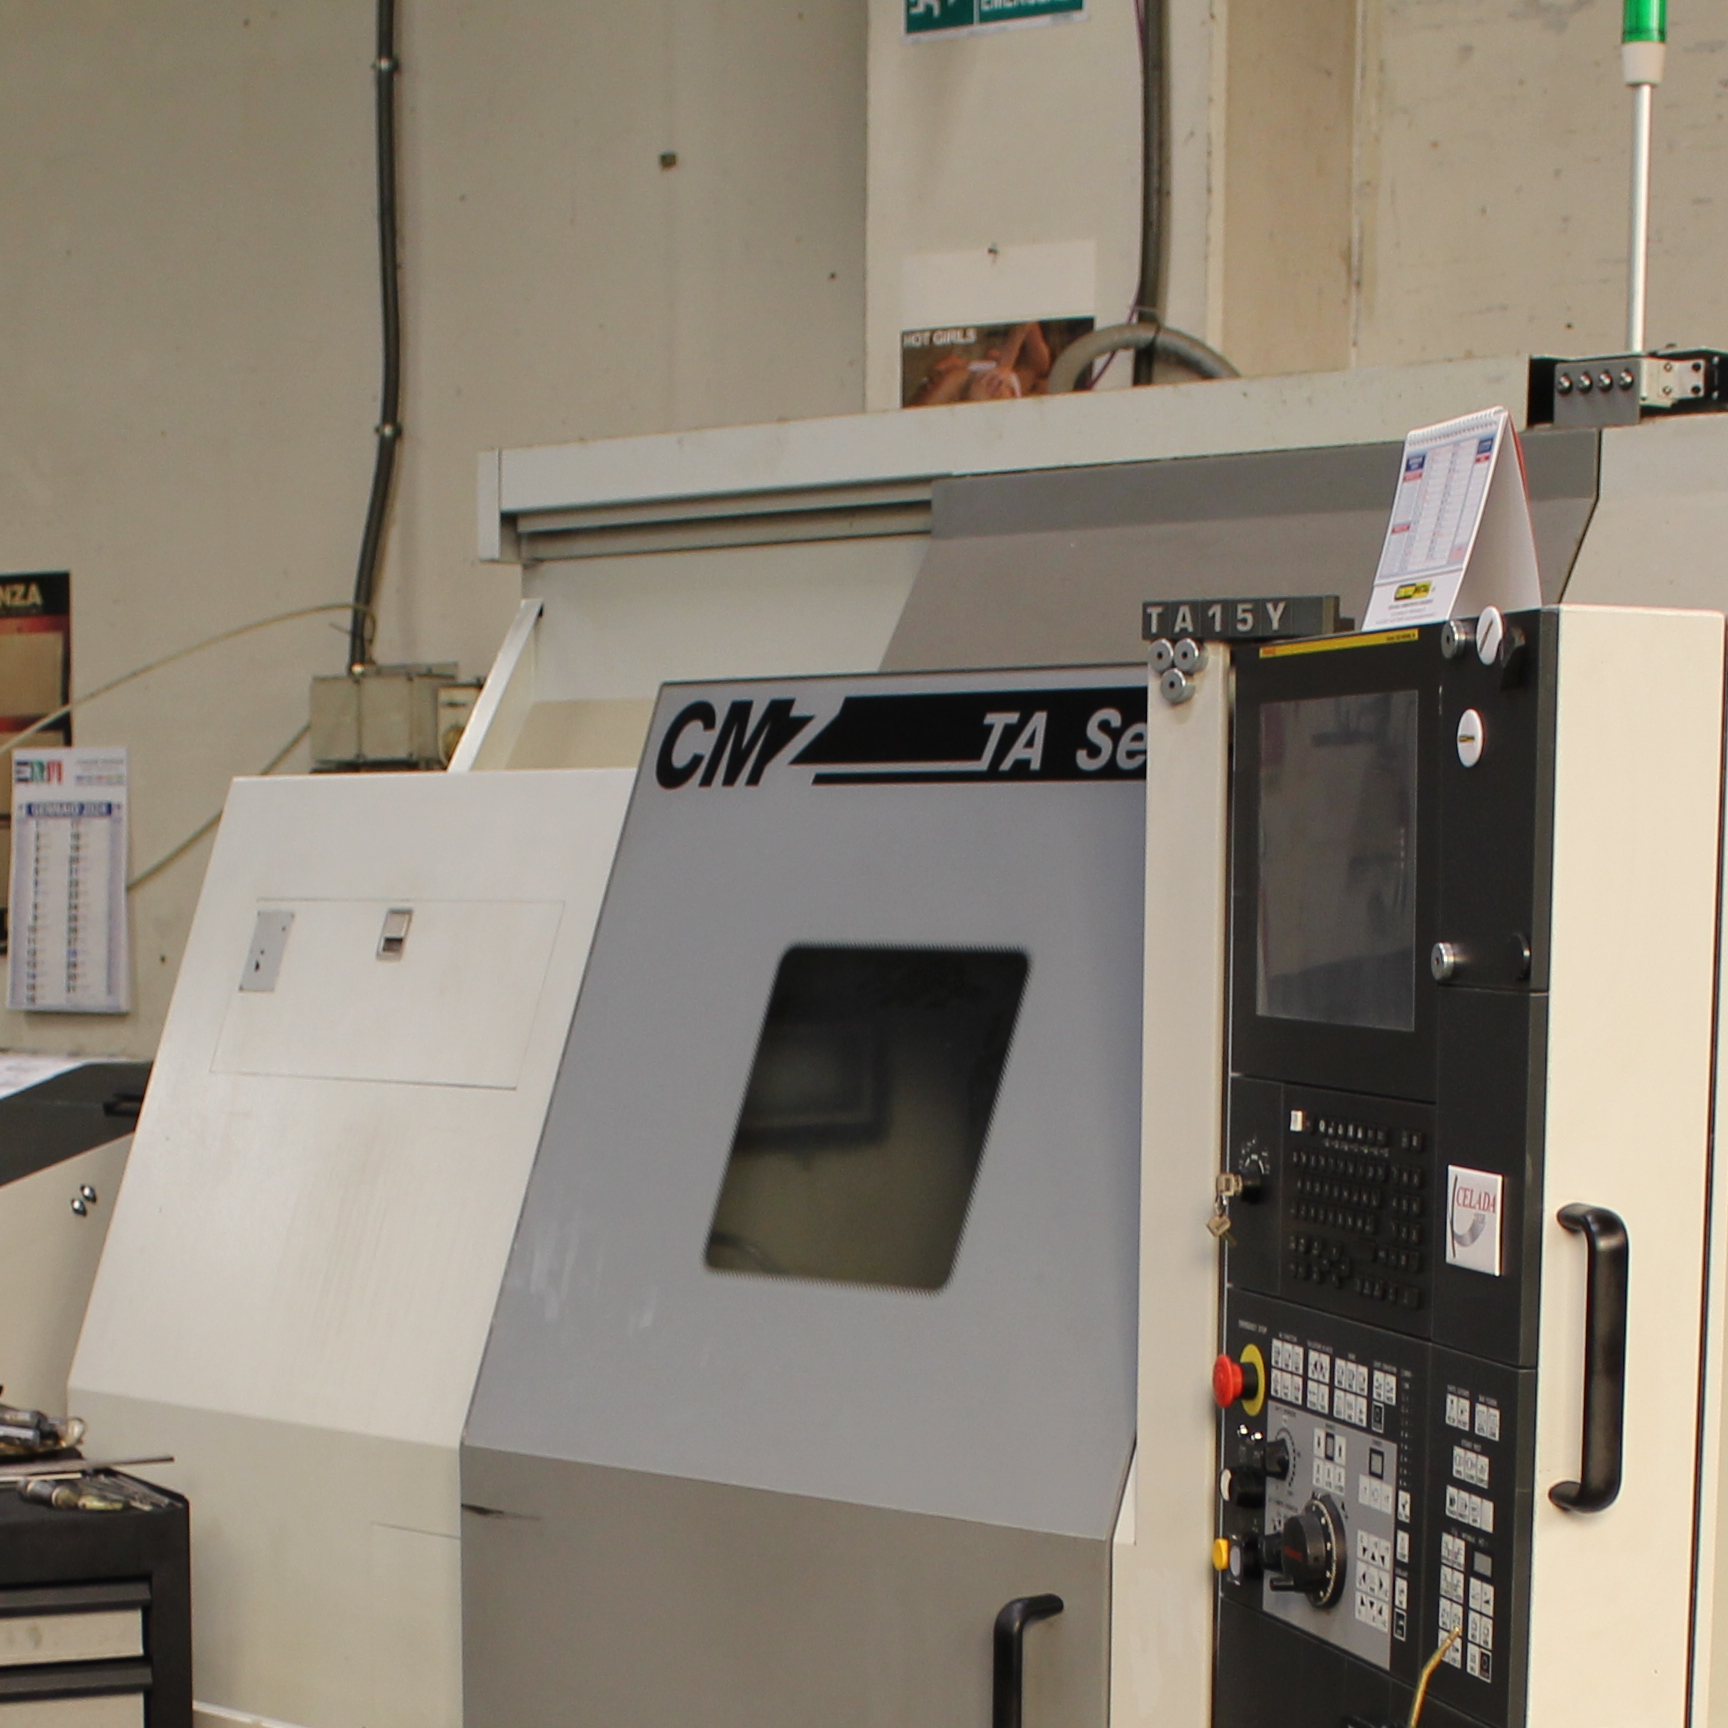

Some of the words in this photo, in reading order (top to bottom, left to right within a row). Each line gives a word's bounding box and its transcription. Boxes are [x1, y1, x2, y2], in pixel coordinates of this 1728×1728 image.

[655, 693, 845, 790] CMZ
[979, 711, 1048, 772] TA
[1457, 1187, 1496, 1213] CELADA
